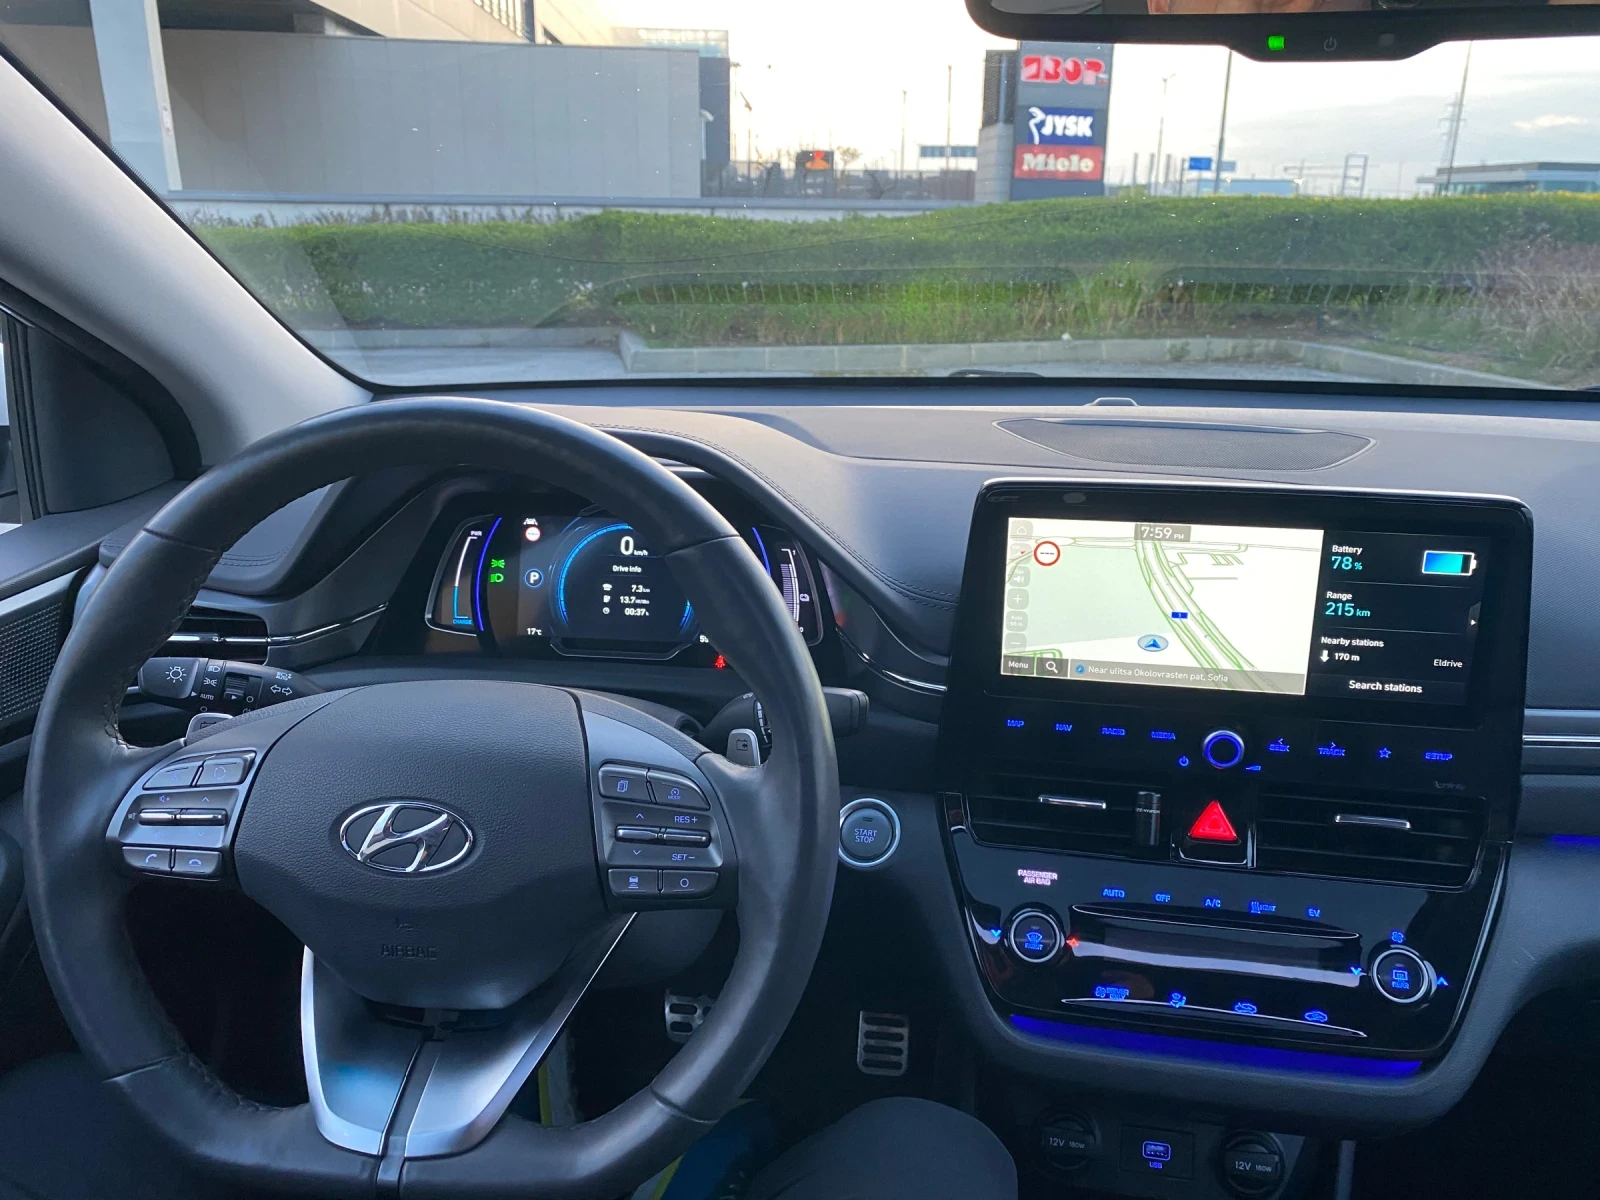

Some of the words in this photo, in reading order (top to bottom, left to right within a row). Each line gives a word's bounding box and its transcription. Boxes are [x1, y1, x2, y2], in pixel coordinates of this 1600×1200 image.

[1040, 114, 1094, 138] JYSK
[1021, 152, 1095, 173] Miele
[1140, 526, 1172, 539] 7:59
[620, 535, 634, 555] 0
[1332, 544, 1363, 556] Battery
[612, 564, 629, 573] Drive
[1331, 556, 1353, 570] 78
[1354, 562, 1363, 571] %
[529, 571, 539, 584] P
[631, 584, 643, 593] 7.3
[620, 595, 636, 604] 13.7
[1326, 591, 1353, 601] Range
[624, 607, 646, 616] 00:37
[1325, 602, 1355, 617] 215
[1356, 609, 1371, 617] km
[1321, 636, 1351, 647] Nearby
[1351, 639, 1385, 648] stations
[1334, 652, 1350, 661] 170
[1351, 654, 1360, 662] m
[1008, 660, 1029, 669] Menu
[1433, 658, 1463, 668] Eldrive
[1088, 666, 1108, 674] Near
[1109, 667, 1132, 676] ulitsa
[1133, 669, 1188, 680] Okolovrasten
[1207, 673, 1229, 682] Sofia
[1348, 680, 1383, 691] Search
[1384, 683, 1423, 693] stations
[200, 693, 214, 701] AUTO
[1007, 719, 1025, 728] MAP
[1055, 723, 1073, 732] NAV
[1101, 727, 1126, 736] RADIO
[1151, 731, 1176, 740] MEDIA
[1318, 747, 1346, 757] TRACK
[1425, 752, 1453, 761] SETUP
[674, 815, 690, 824] RES
[854, 828, 878, 837] START
[855, 835, 875, 844] STOP
[671, 853, 687, 861] SET
[1017, 869, 1058, 880] PASSENGER
[1023, 876, 1036, 885] AIR
[1102, 888, 1125, 898] AUTO
[1155, 893, 1171, 902] OFF
[1205, 899, 1221, 908] A/C
[1308, 908, 1321, 918] EV
[380, 944, 438, 961] AIRBAG
[1050, 1137, 1065, 1147] 12V
[1149, 1161, 1163, 1169] USB
[1235, 1160, 1251, 1171] 12V
